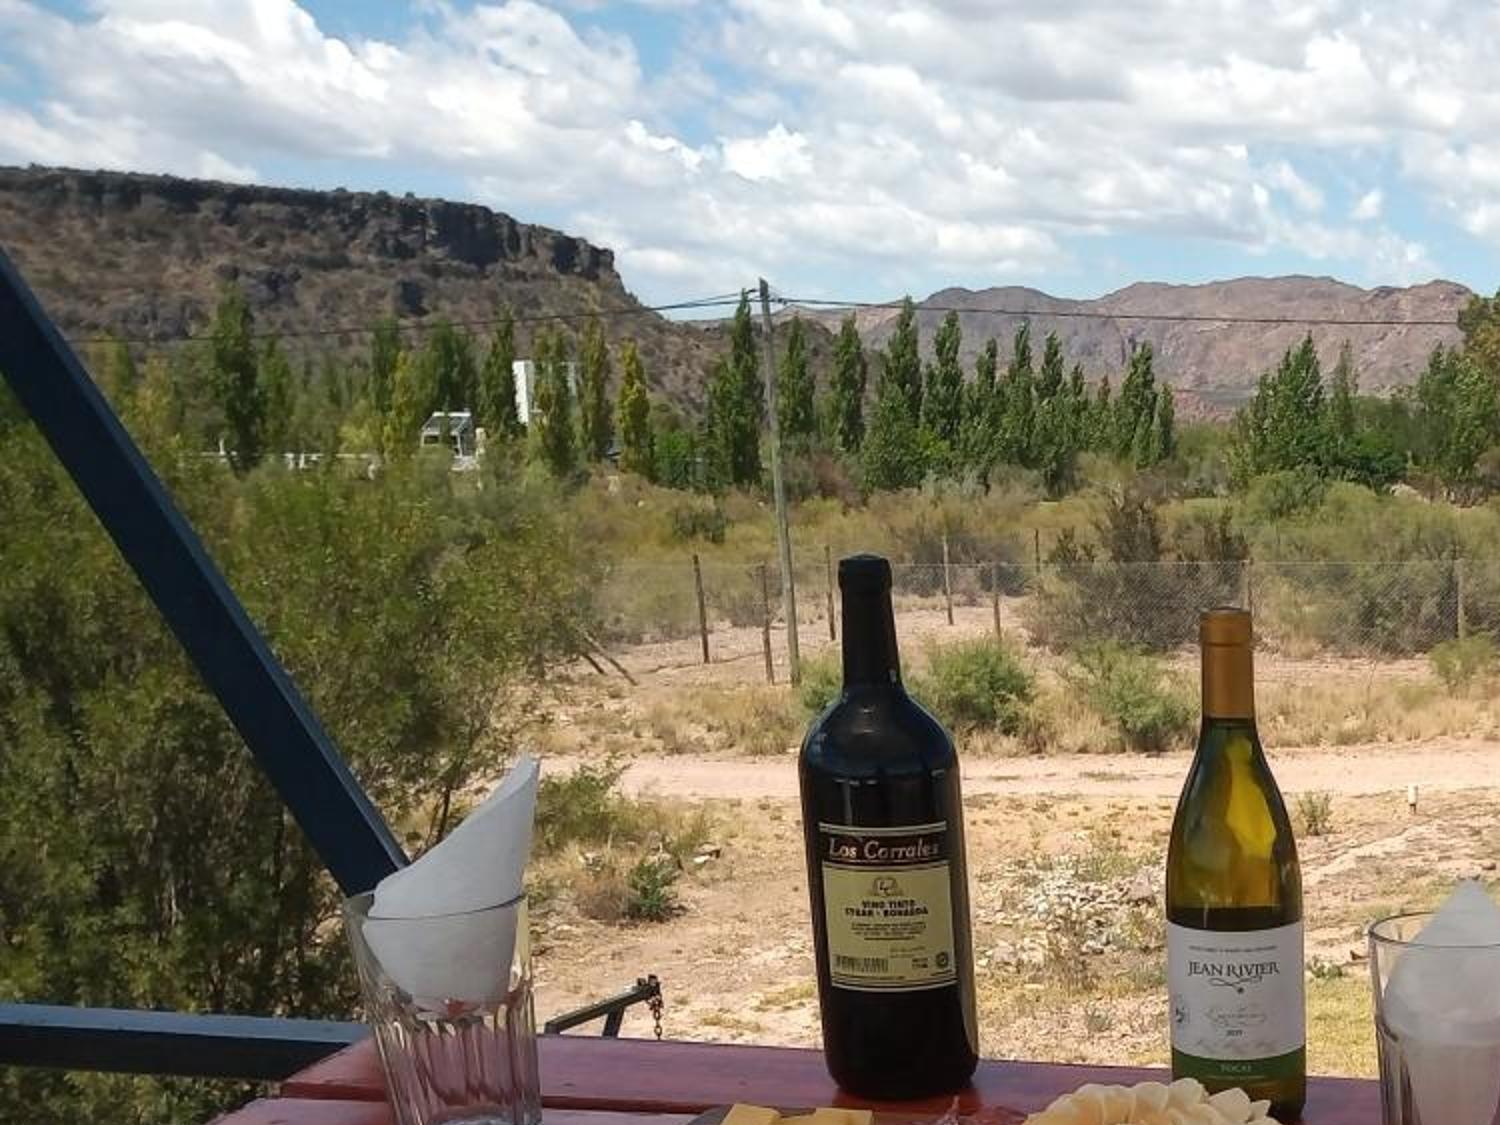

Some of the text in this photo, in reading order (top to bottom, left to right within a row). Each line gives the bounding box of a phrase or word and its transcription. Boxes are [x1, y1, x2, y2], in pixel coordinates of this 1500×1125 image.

[830, 838, 938, 859] Los Corrales
[1187, 961, 1281, 979] JEAN RIVIER
